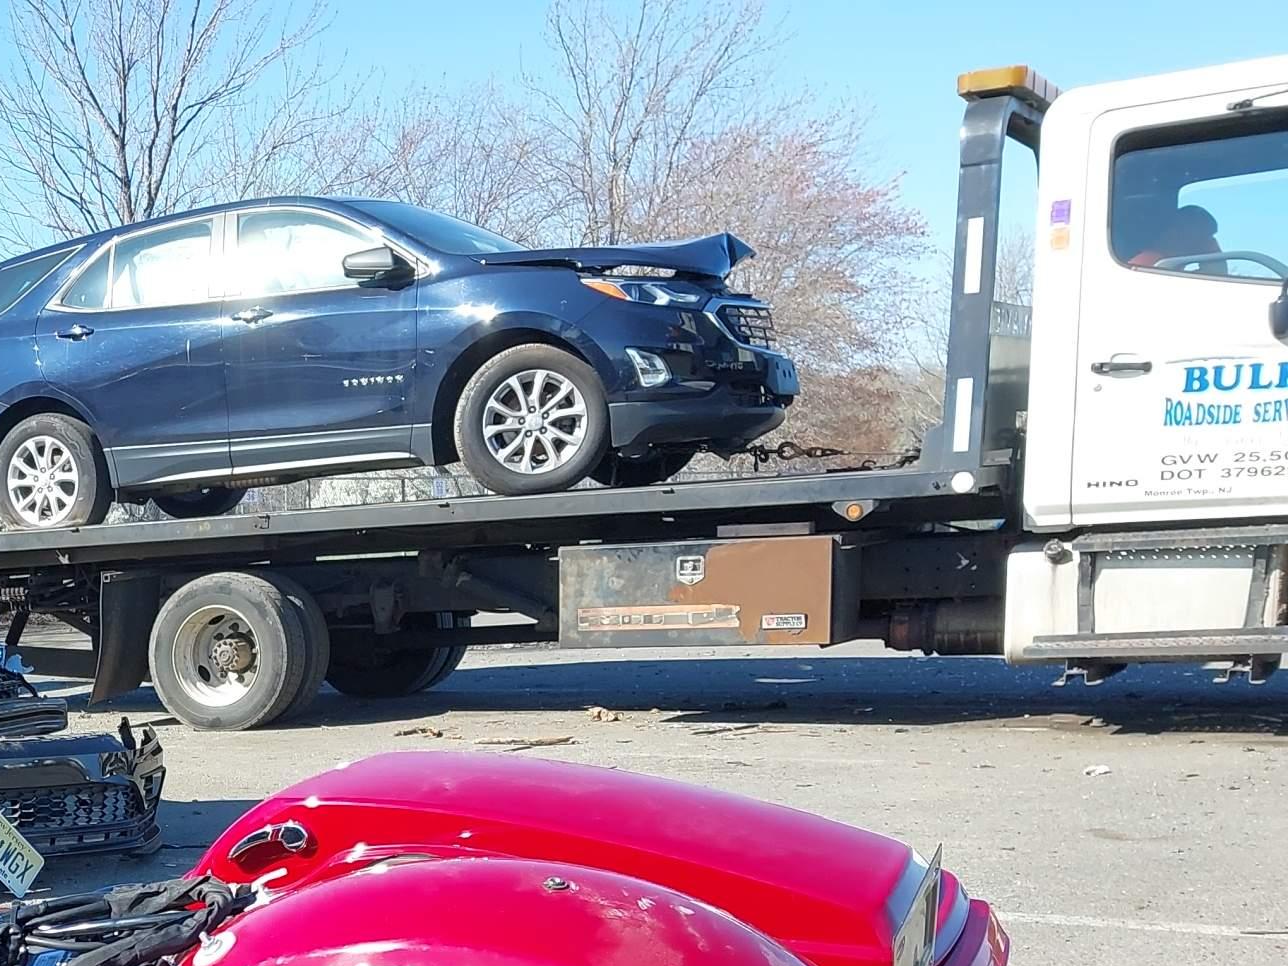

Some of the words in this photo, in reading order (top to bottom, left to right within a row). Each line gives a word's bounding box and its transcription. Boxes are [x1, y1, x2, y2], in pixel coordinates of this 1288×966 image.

[1163, 397, 1243, 427] ROADSIDE
[1161, 453, 1219, 466] GVW
[1160, 468, 1207, 481] DOT
[1220, 465, 1288, 478] 37962
[1086, 479, 1139, 488] HINO
[1144, 488, 1183, 497] Monroe
[1218, 486, 1233, 495] NJ
[0, 842, 34, 885] WGX
